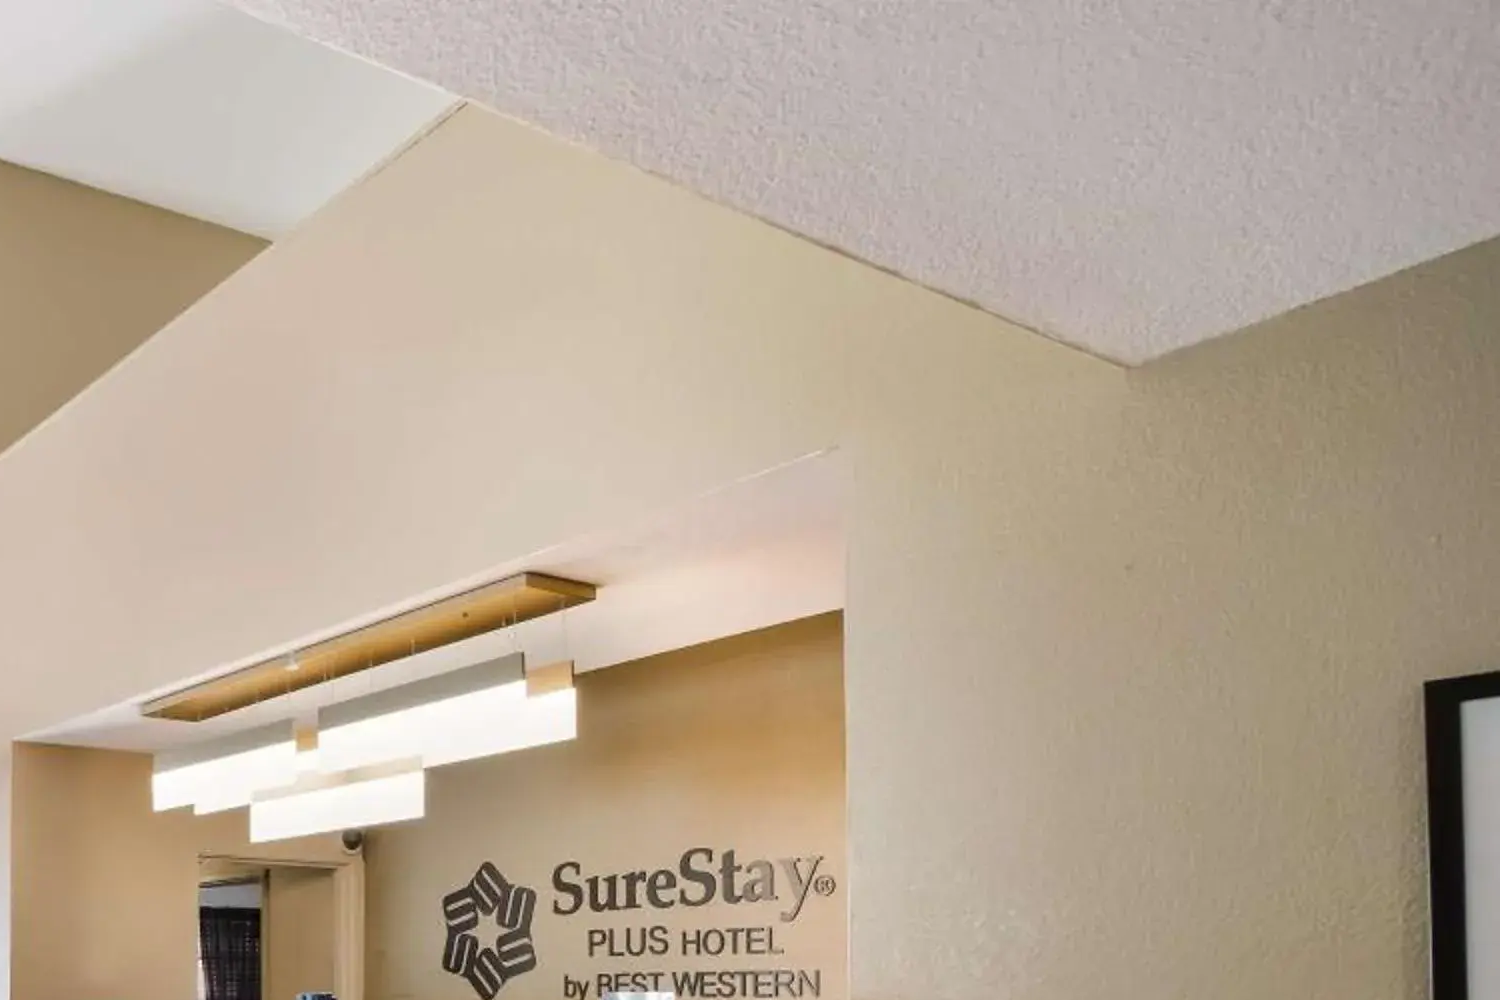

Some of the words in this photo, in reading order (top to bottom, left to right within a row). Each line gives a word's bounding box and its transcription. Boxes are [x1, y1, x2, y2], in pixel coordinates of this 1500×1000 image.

[587, 925, 669, 957] PLUS
[681, 926, 785, 956] HOTEL
[597, 972, 665, 997] BEST
[672, 969, 822, 999] WESTERN
